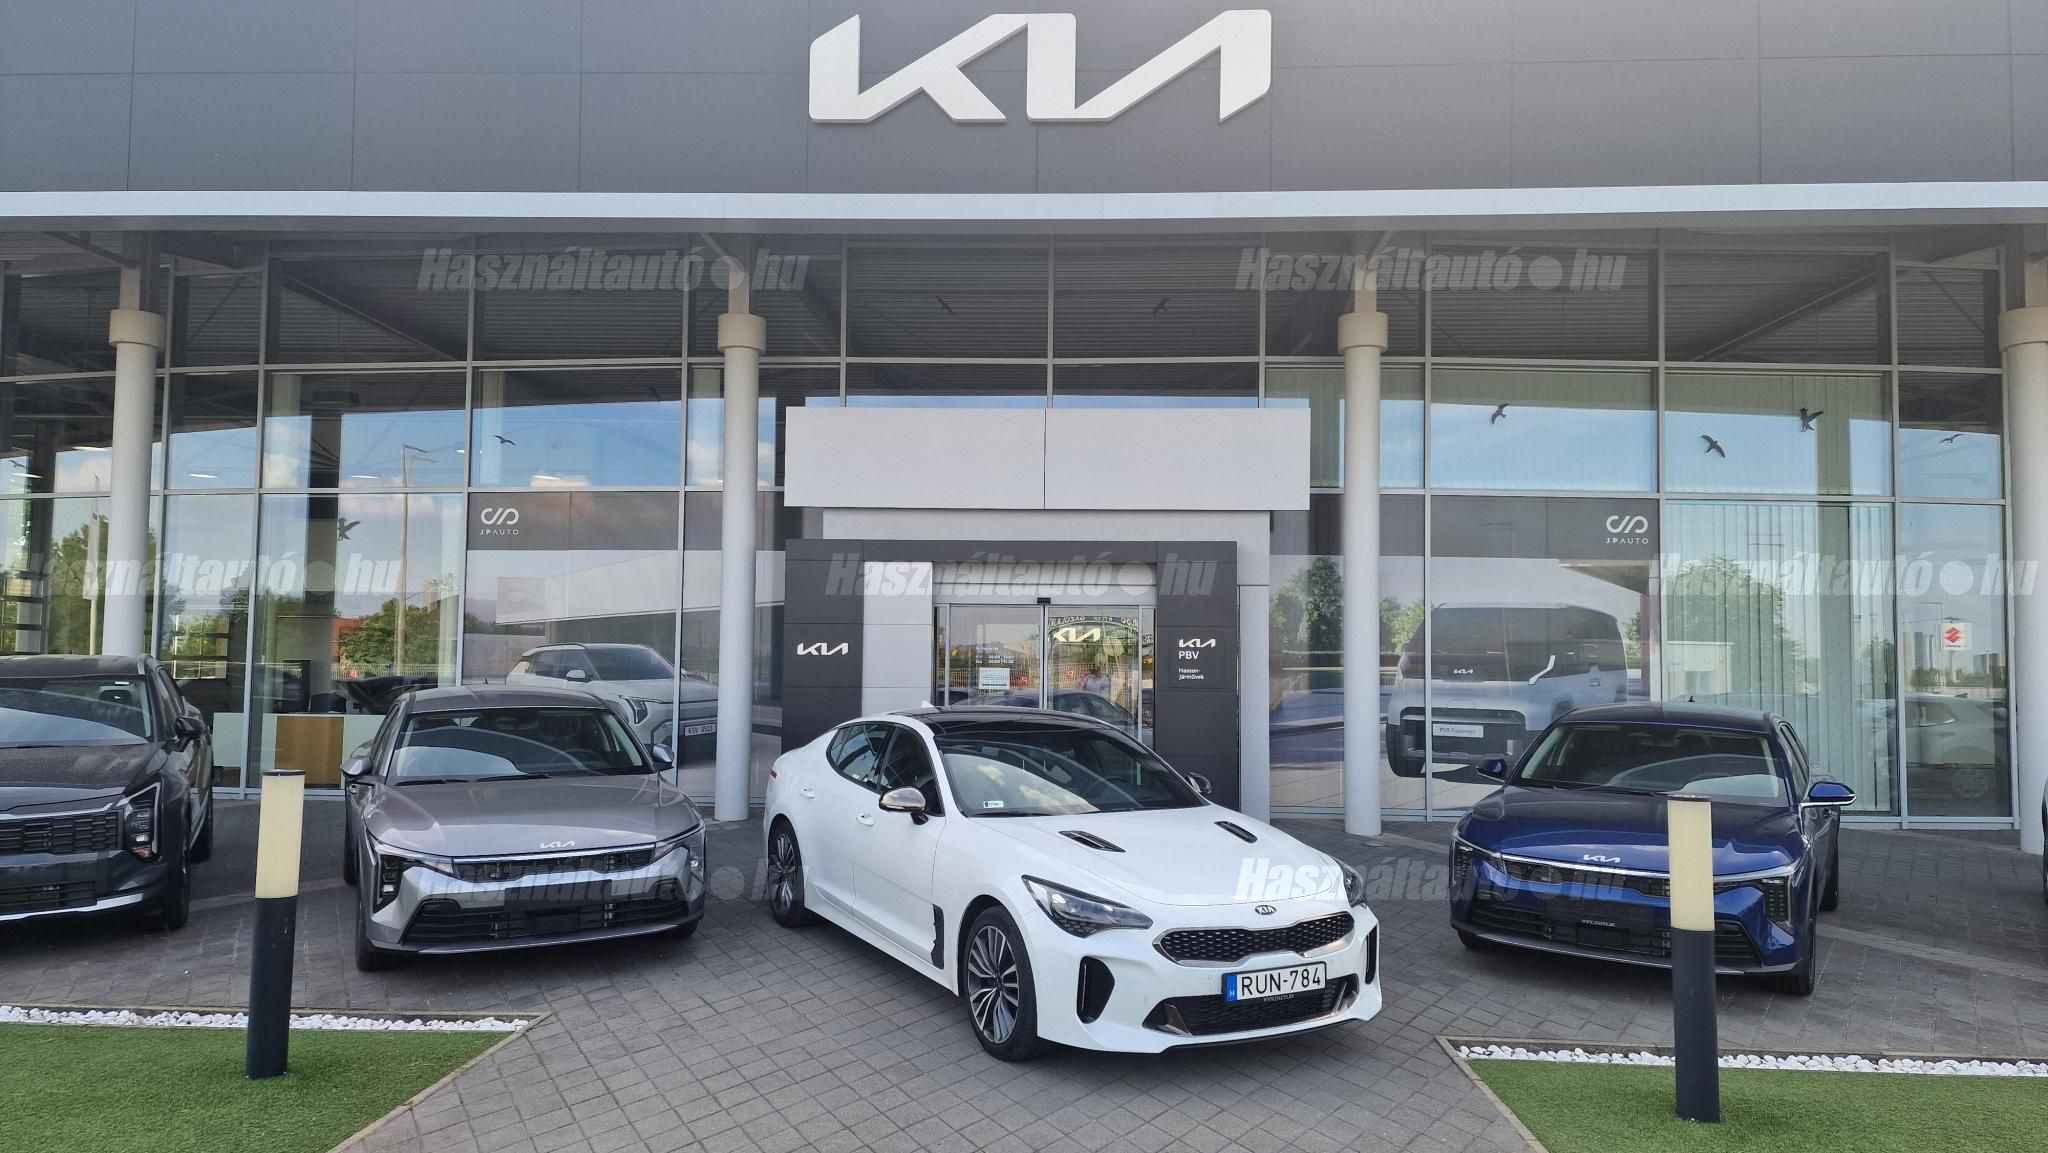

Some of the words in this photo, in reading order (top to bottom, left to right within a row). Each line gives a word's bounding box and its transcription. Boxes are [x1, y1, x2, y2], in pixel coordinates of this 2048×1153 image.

[809, 10, 1272, 123] KIA
[1178, 638, 1216, 648] KIA
[797, 642, 849, 656] KIA
[1178, 650, 1200, 660] PBV
[1583, 854, 1621, 864] KIA
[1256, 905, 1276, 914] KIA
[1241, 967, 1321, 996] RUN-784
[1229, 990, 1235, 998] H
